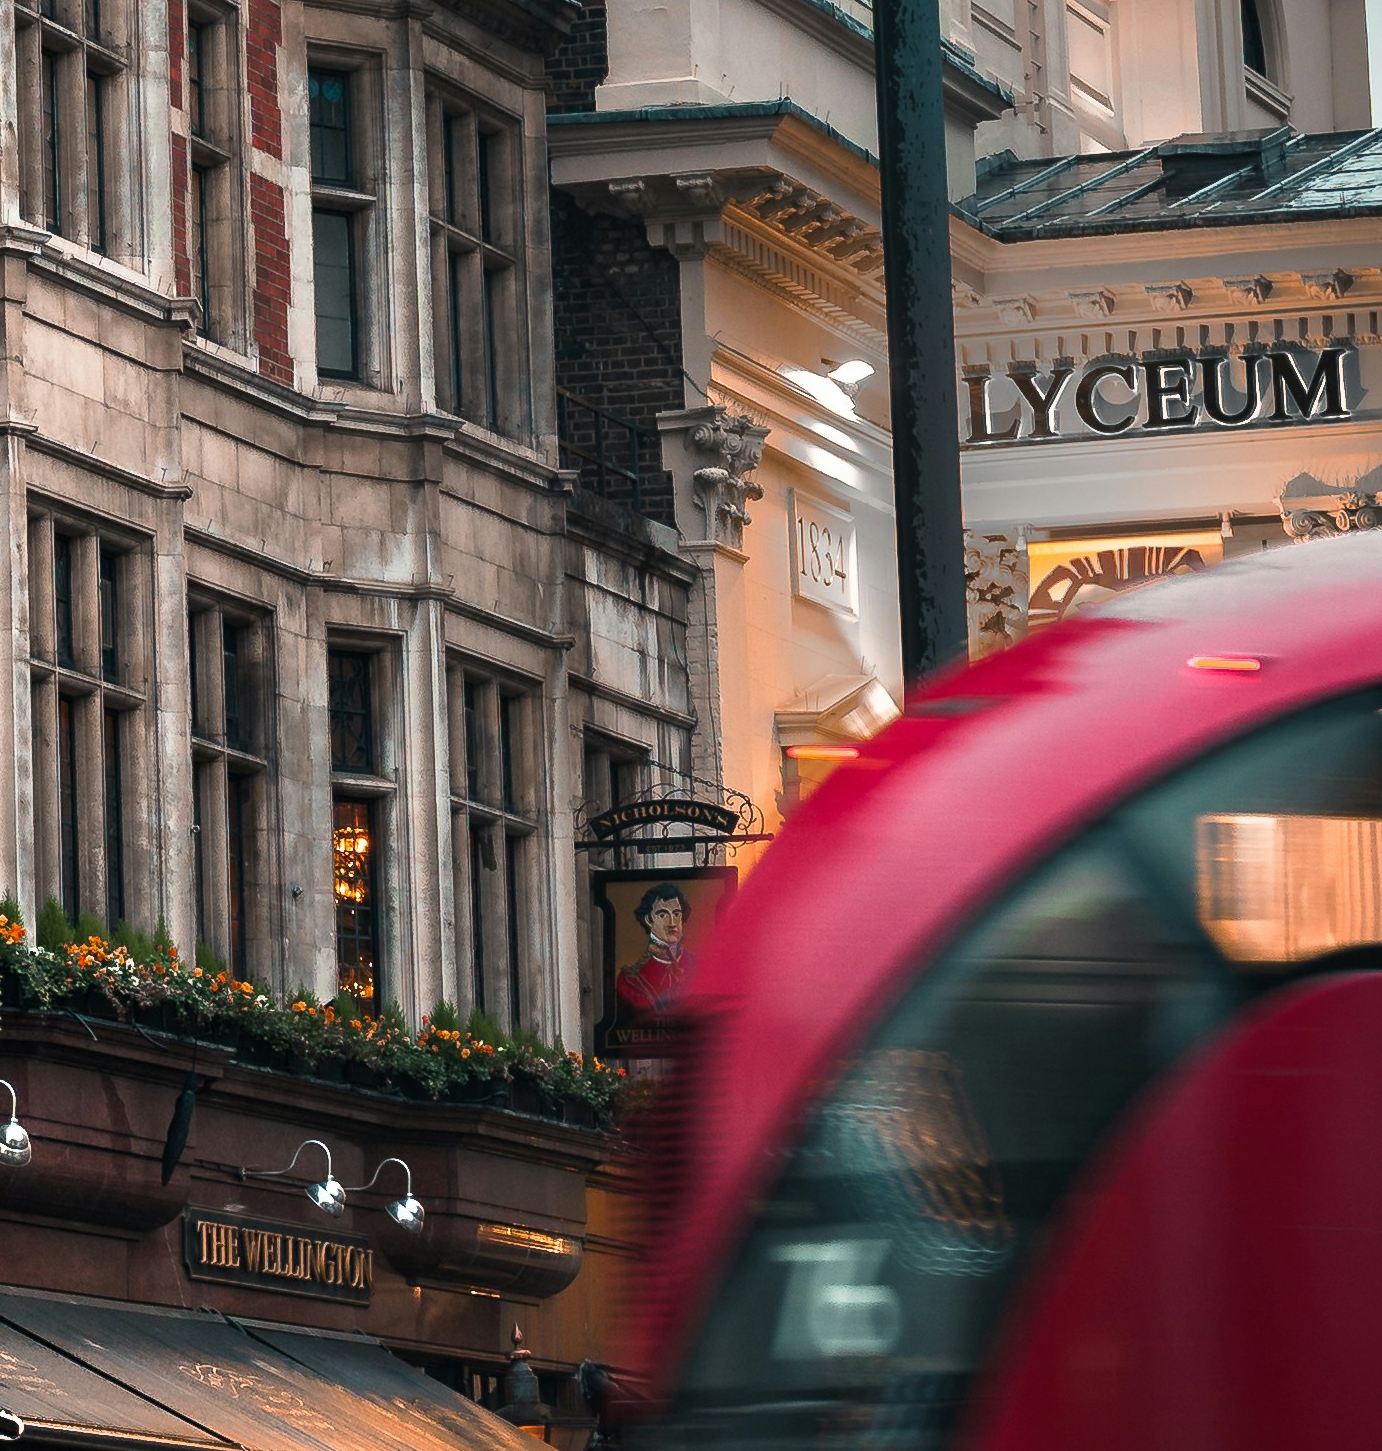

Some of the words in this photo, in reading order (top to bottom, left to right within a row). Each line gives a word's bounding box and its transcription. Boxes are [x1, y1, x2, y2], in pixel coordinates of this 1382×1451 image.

[962, 348, 1352, 443] LYCEUM
[798, 517, 846, 594] 1834
[197, 1220, 240, 1267] THE
[242, 1228, 374, 1289] WELLINGTON
